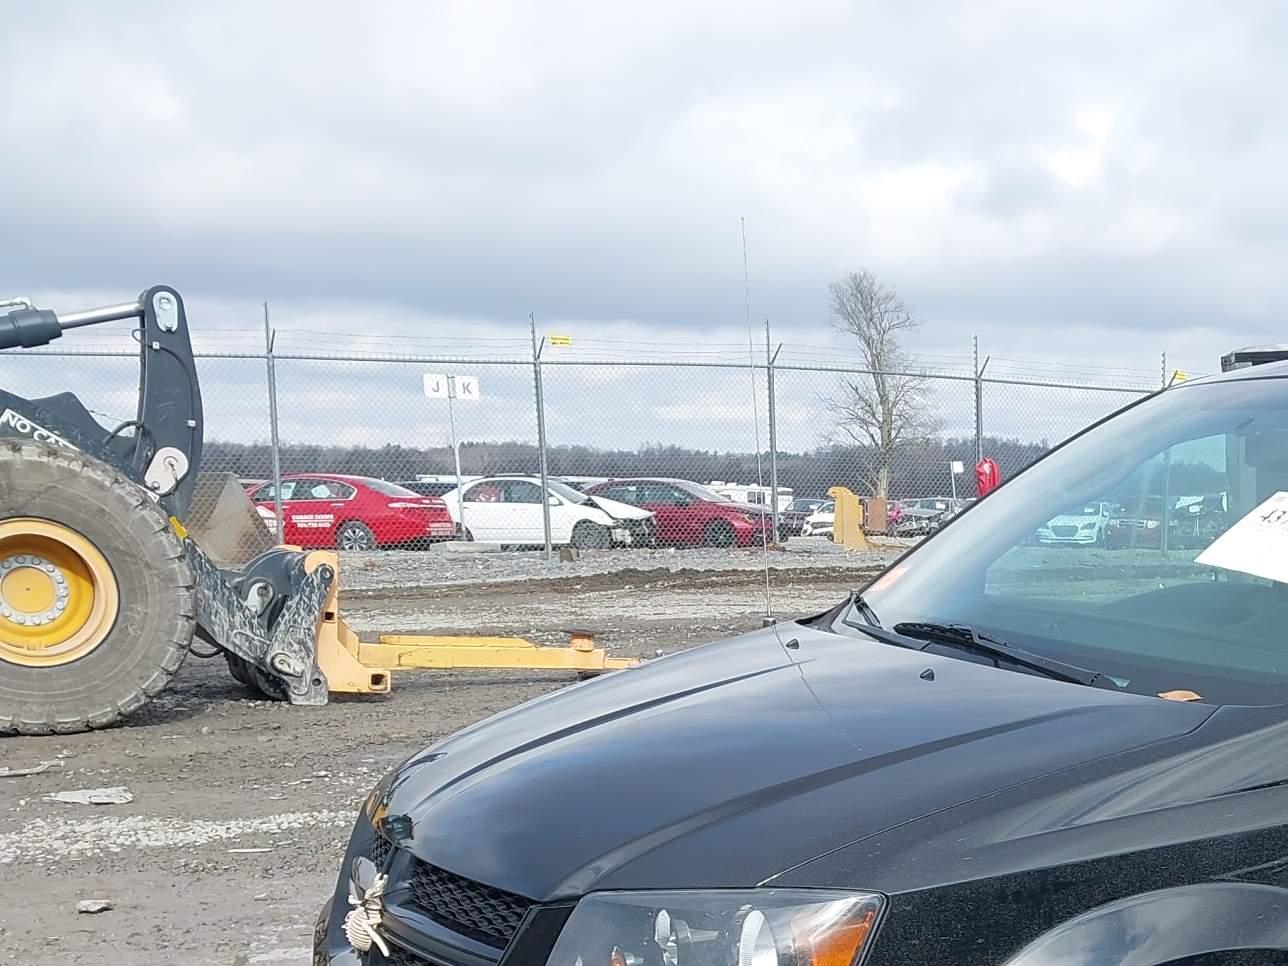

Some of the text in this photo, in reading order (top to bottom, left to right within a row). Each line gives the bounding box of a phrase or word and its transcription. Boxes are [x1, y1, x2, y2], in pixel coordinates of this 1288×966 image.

[431, 380, 440, 393] J
[462, 382, 472, 394] K
[2, 412, 31, 433] NO
